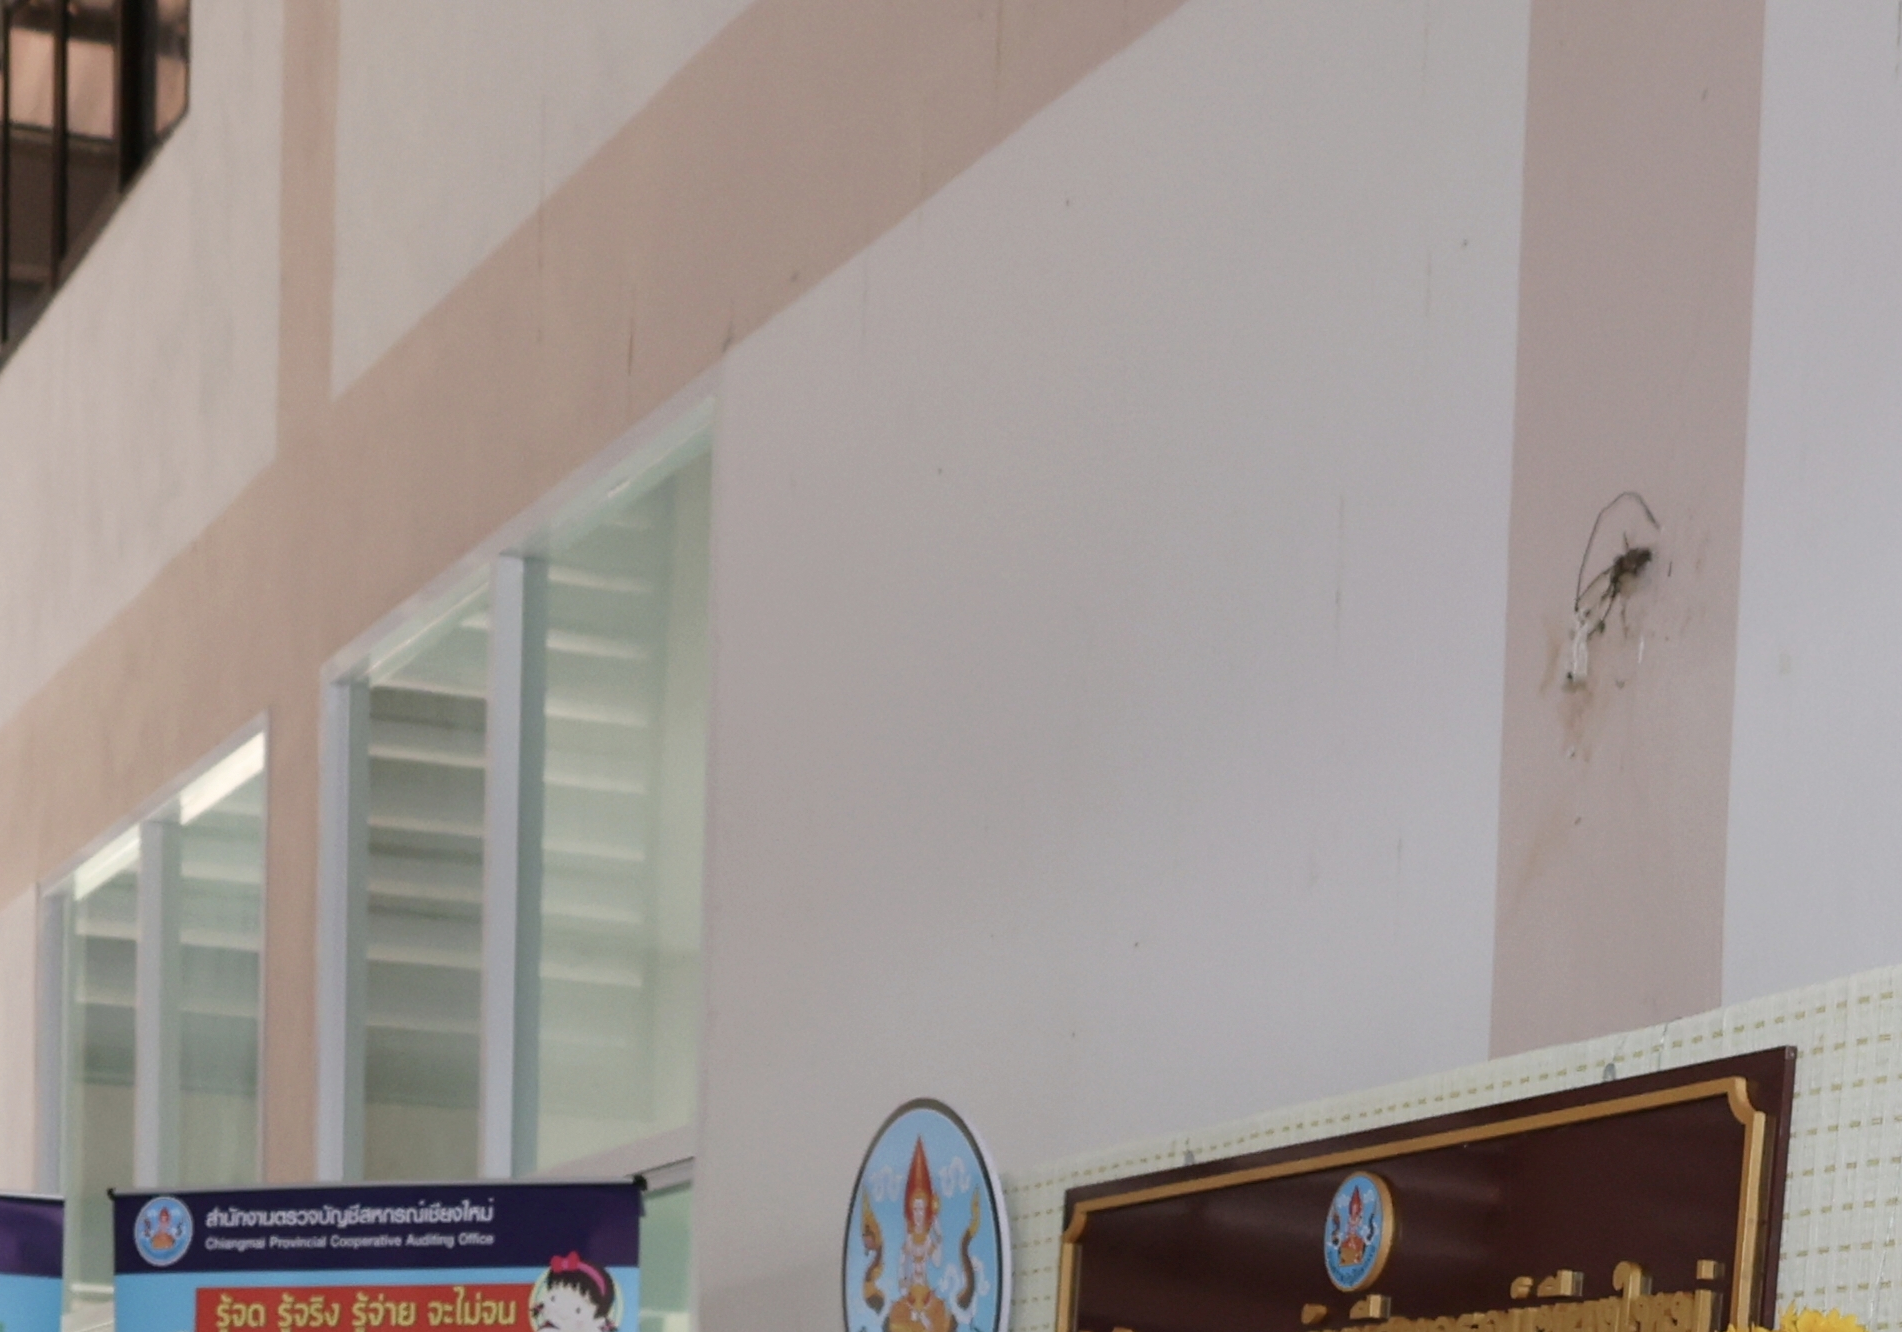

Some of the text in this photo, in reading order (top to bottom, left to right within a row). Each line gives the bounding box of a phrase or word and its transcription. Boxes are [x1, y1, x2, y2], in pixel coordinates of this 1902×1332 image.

[206, 1199, 494, 1229] สำนักงานตรวจบัญชีสหกรณ์เชียงใหม่
[205, 1232, 495, 1251] Chiangmai Provincial Cooperative Auditing Office
[427, 1286, 517, 1328] จะไม่จน
